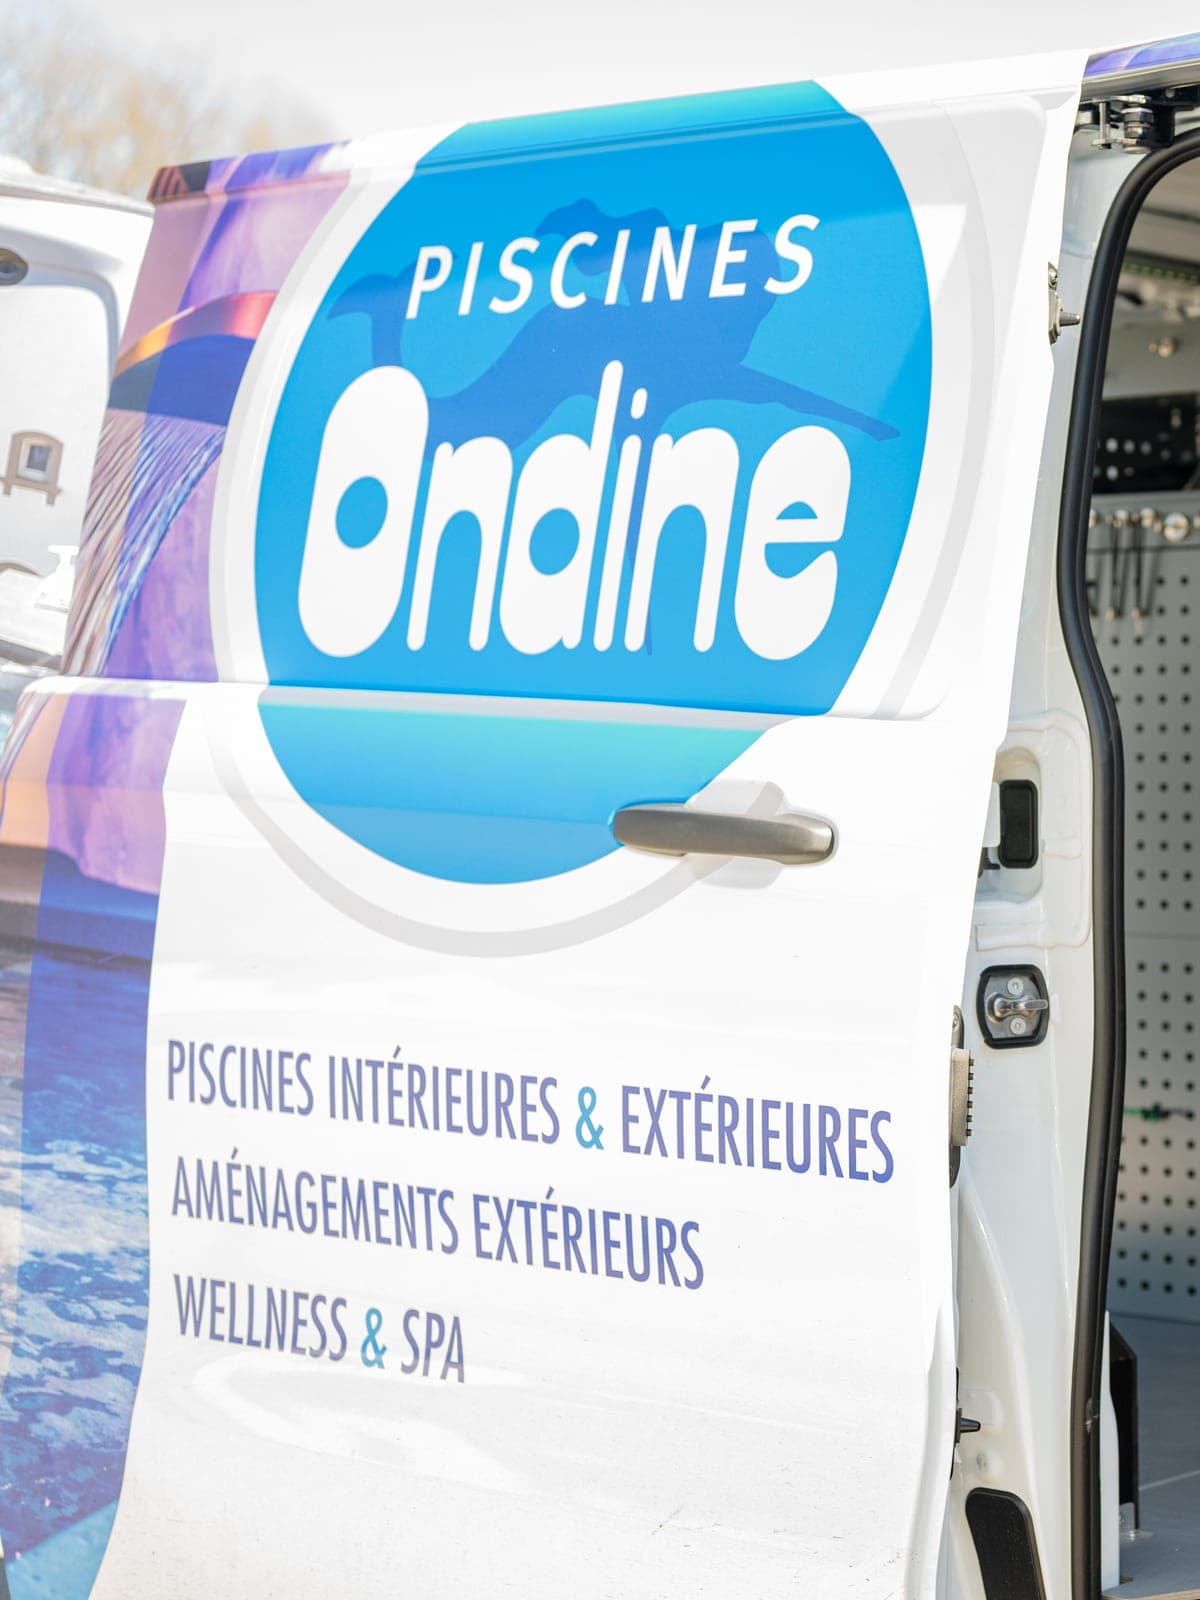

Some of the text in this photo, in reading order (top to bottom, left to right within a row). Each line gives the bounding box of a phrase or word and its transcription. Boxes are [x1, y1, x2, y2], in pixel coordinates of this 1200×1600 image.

[405, 213, 820, 320] PISCINES
[298, 360, 852, 661] Ondine
[167, 1039, 895, 1184] PISCINES INTÉRIEURES & EXTÉRIEURES
[171, 1148, 705, 1290] AMÉNAGEMENTS EXTÉRIEURS
[173, 1273, 466, 1384] WELLNESS & SPA
